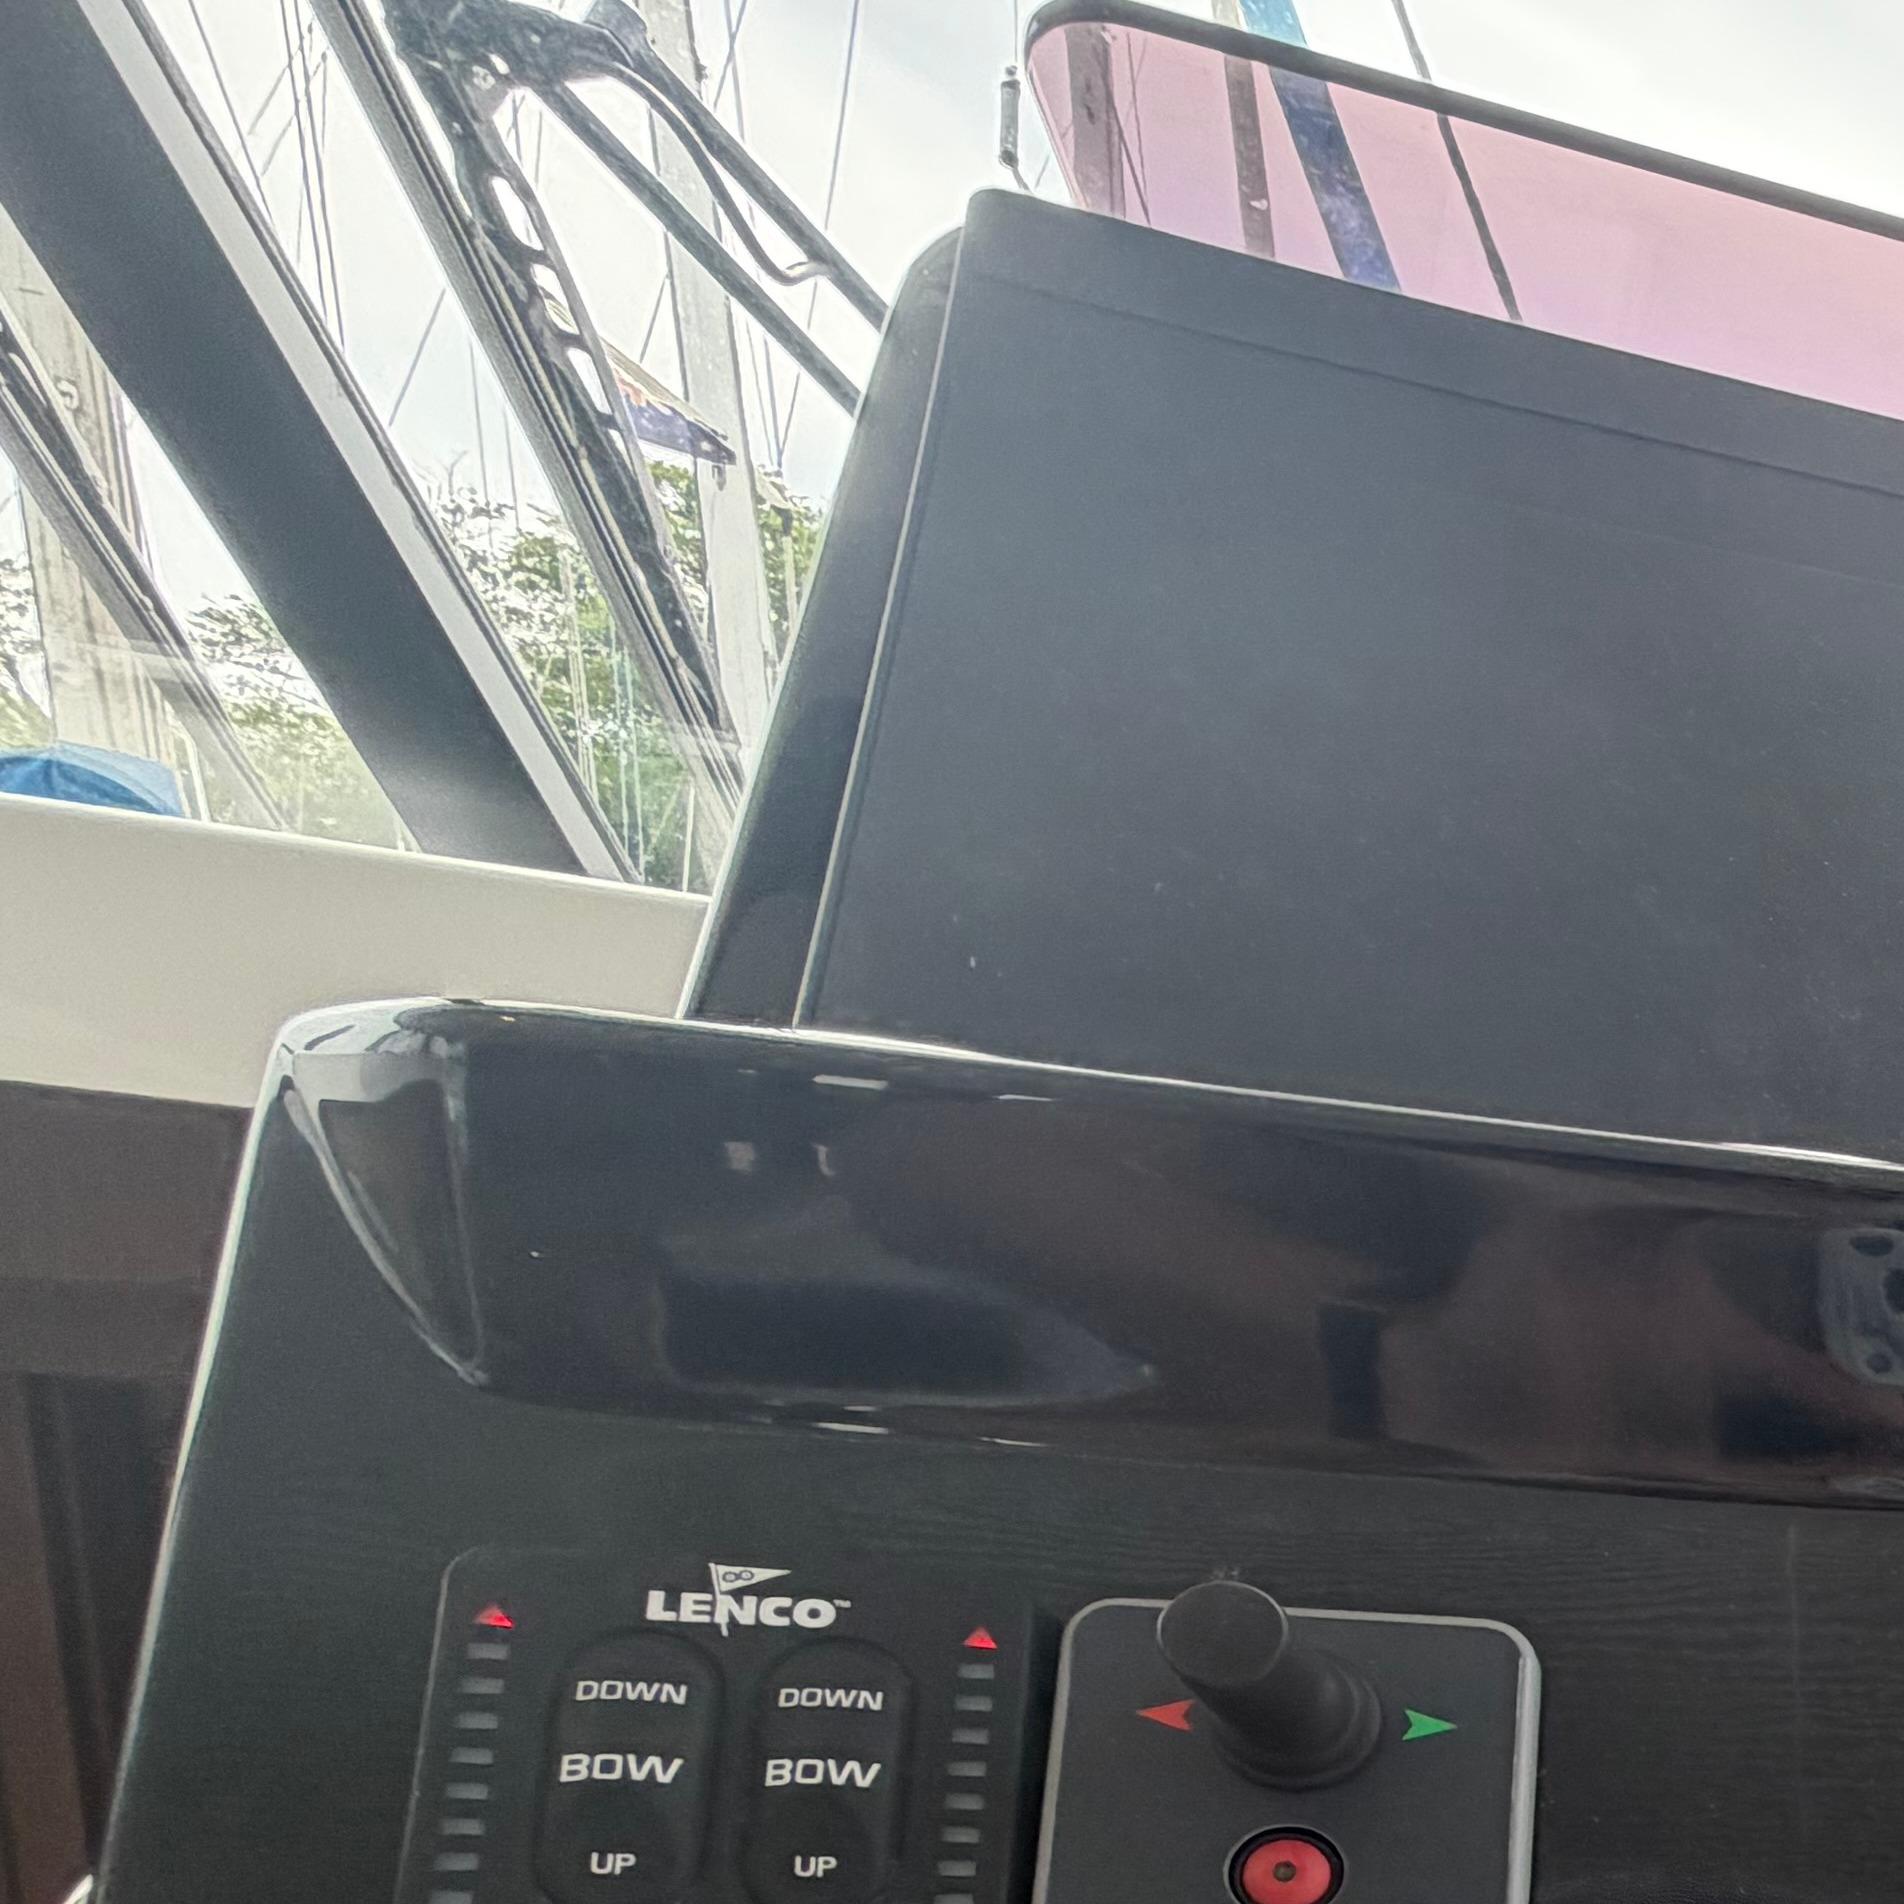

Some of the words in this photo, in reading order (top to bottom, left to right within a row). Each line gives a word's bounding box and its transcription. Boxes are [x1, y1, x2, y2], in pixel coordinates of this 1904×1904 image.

[575, 1680, 687, 1706] DOWN
[778, 1687, 883, 1711] DOWN
[559, 1752, 684, 1784] BOW
[764, 1758, 881, 1788] BOW
[590, 1852, 637, 1876] UP
[793, 1855, 837, 1878] UP
